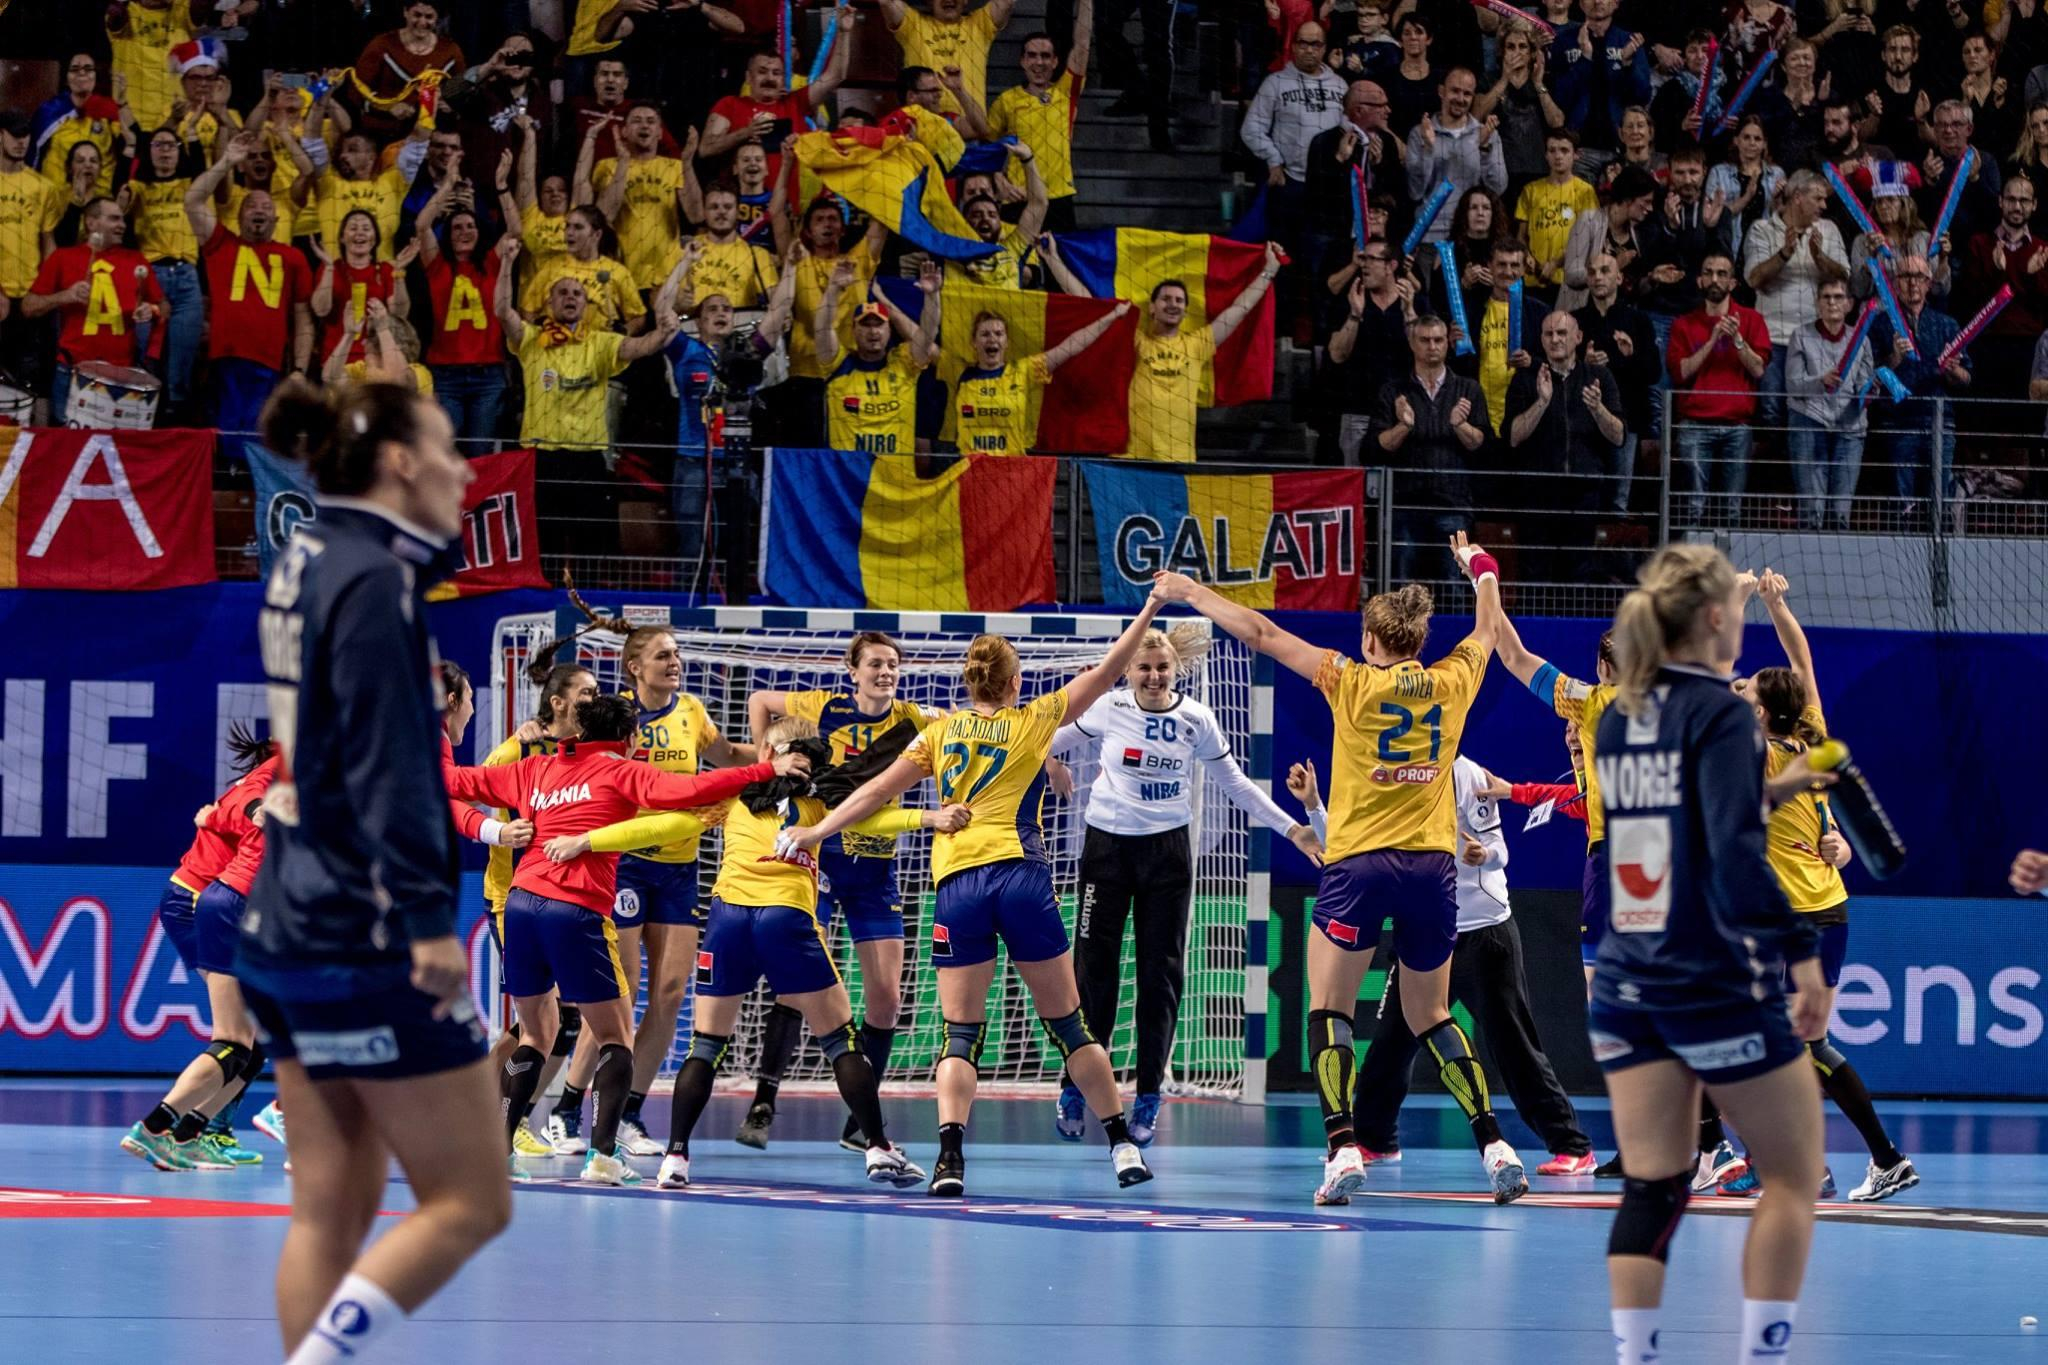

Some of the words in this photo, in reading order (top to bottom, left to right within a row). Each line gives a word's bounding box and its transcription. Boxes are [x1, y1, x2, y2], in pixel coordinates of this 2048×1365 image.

[229, 246, 284, 309] N
[443, 274, 489, 332] A
[864, 400, 901, 416] BRD
[977, 407, 1012, 418] BRD
[855, 432, 897, 454] NIRO
[973, 435, 1007, 450] NIRO
[1114, 505, 1355, 586] GALATI
[641, 724, 671, 749] 90
[847, 724, 874, 751] 11
[1145, 716, 1178, 742] 20
[1377, 701, 1443, 762] 21
[653, 749, 689, 762] BRD
[1145, 755, 1183, 771] BRD
[942, 741, 1009, 804] 27
[1596, 752, 1683, 811] NORGE
[1140, 781, 1181, 801] NIRO
[1079, 883, 1098, 940] Kempa
